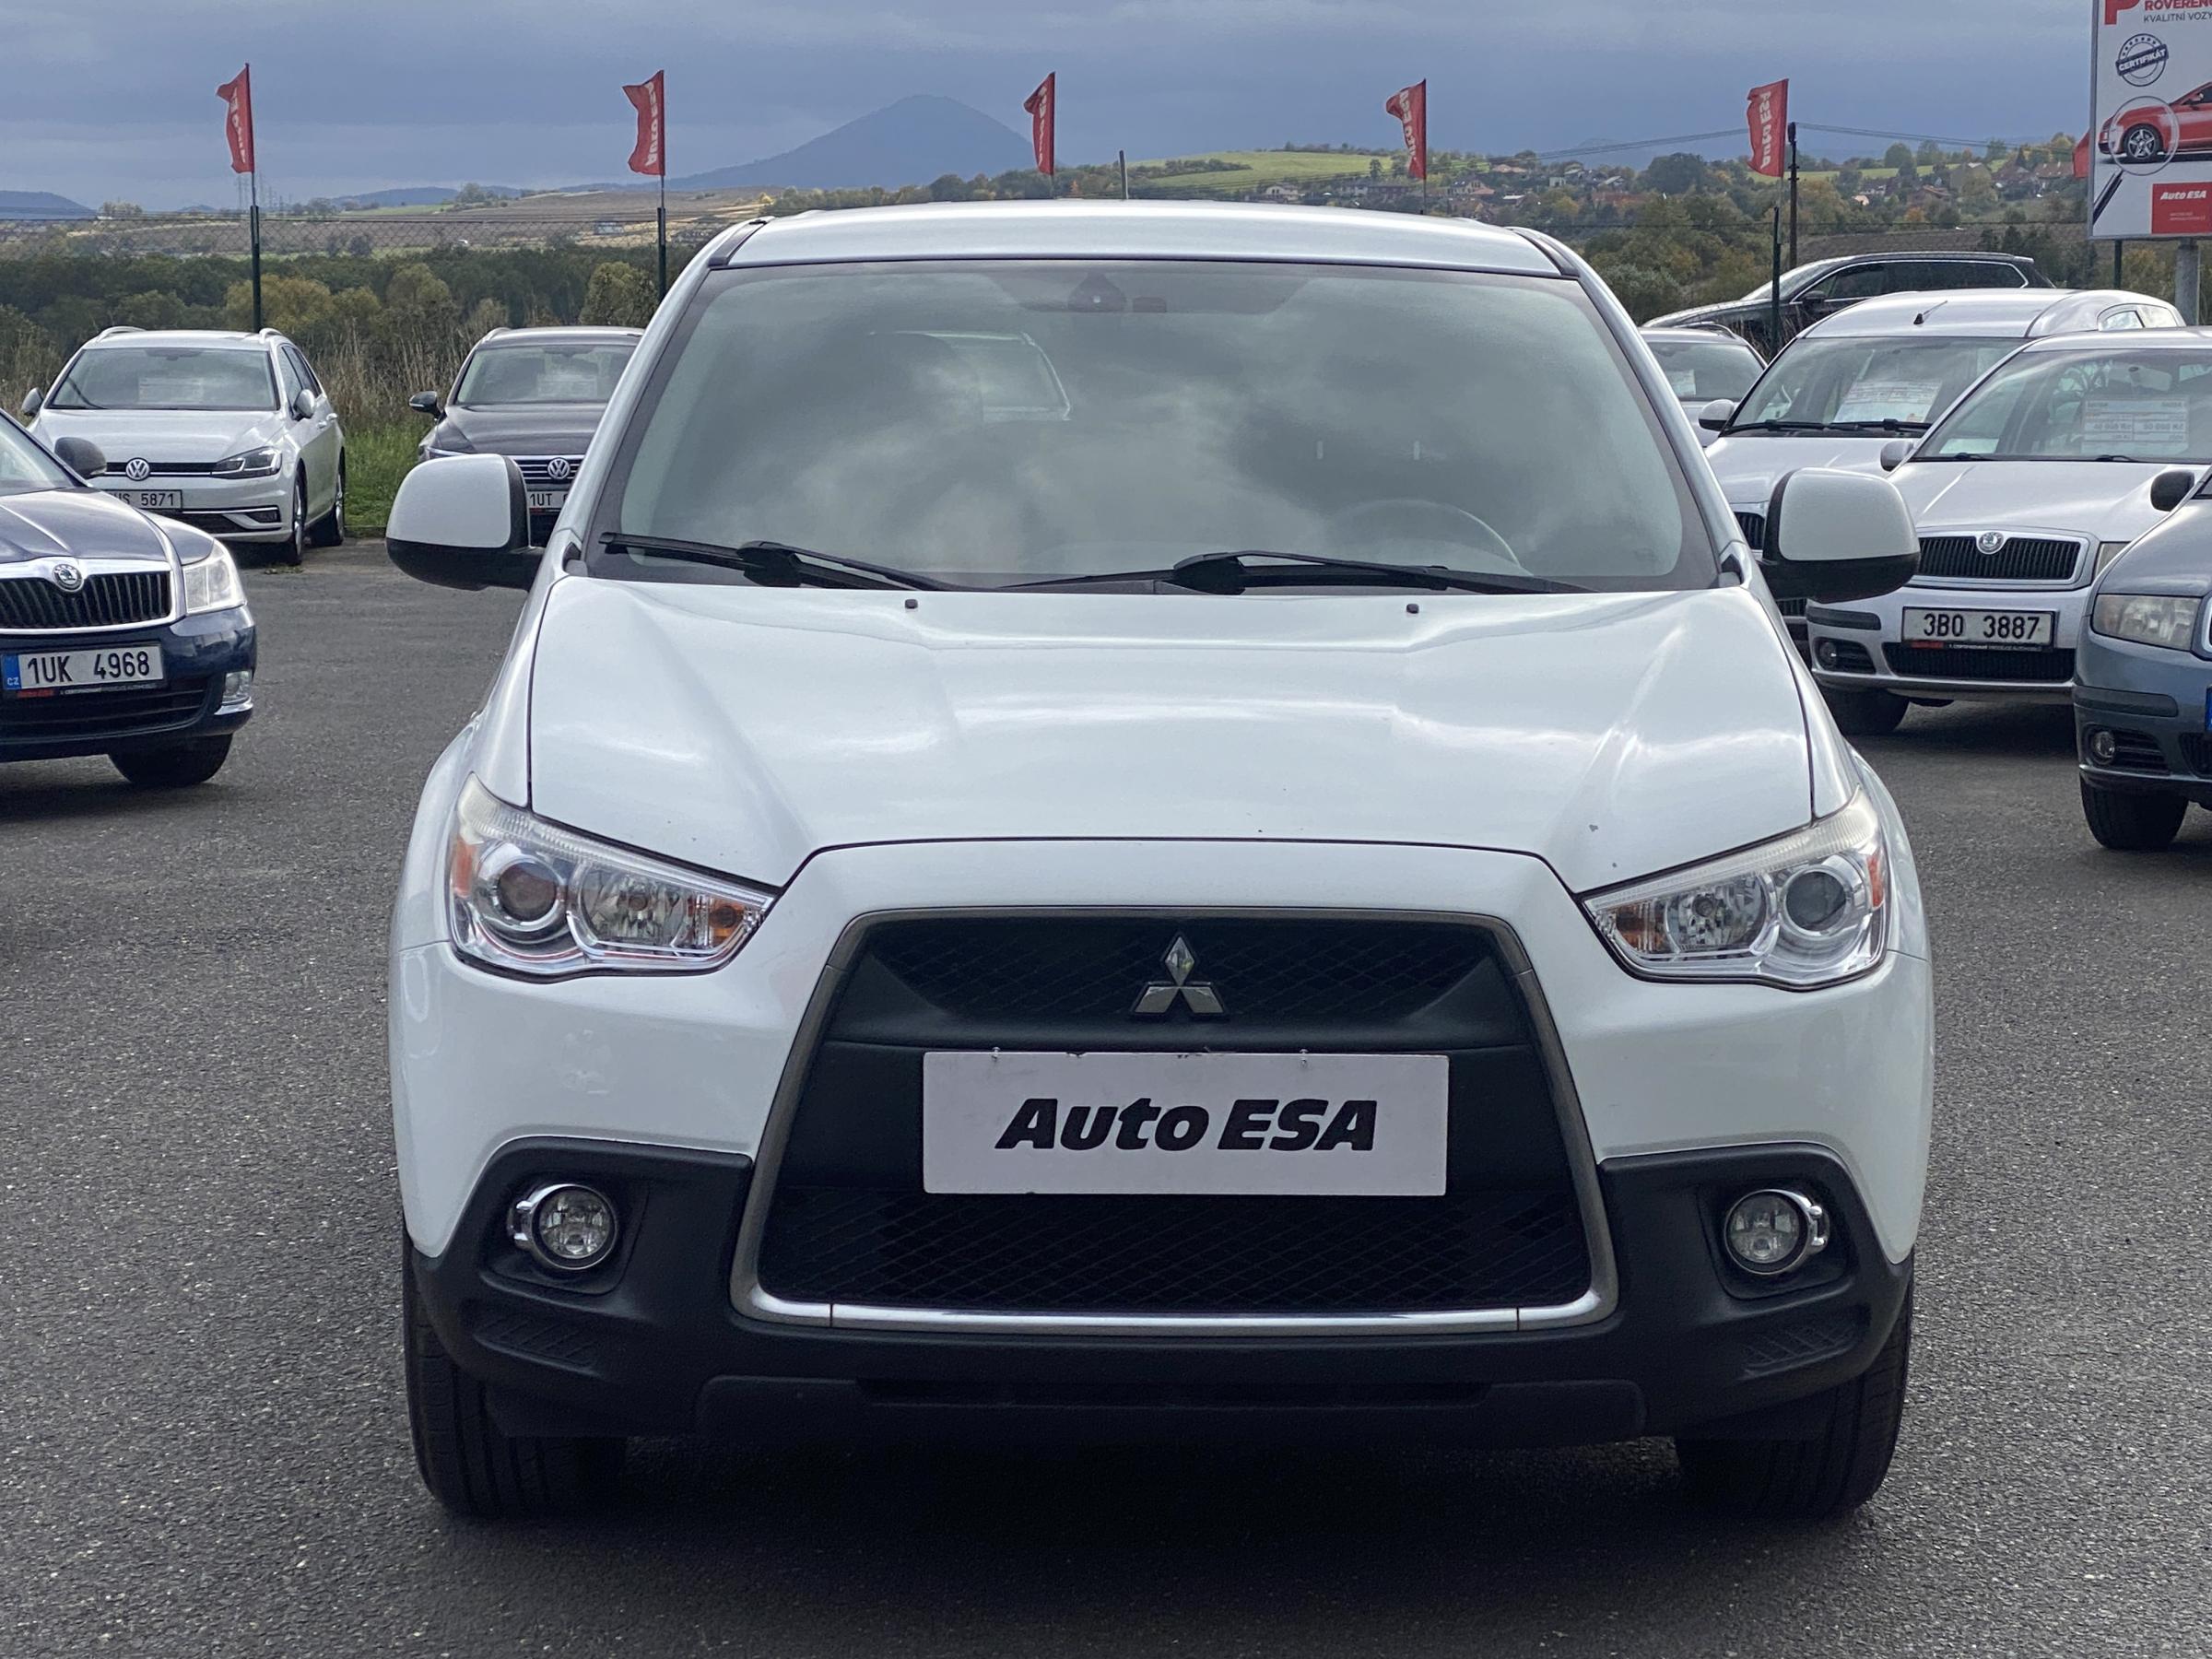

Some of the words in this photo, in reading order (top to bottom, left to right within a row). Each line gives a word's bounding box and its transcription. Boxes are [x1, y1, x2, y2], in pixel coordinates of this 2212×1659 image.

[2144, 11, 2185, 22] KVALITNÍ
[2119, 49, 2166, 71] CERTIFIKÁT
[2160, 192, 2186, 200] Auto
[2186, 190, 2206, 199] ESA
[141, 493, 174, 506] 5871
[530, 493, 553, 506] 1UT
[1983, 615, 2040, 640] 3887
[6, 677, 19, 687] CZ
[28, 655, 73, 684] 1UK
[94, 651, 149, 679] 4968
[994, 1098, 1209, 1151] Auto
[1218, 1098, 1379, 1151] ESA
